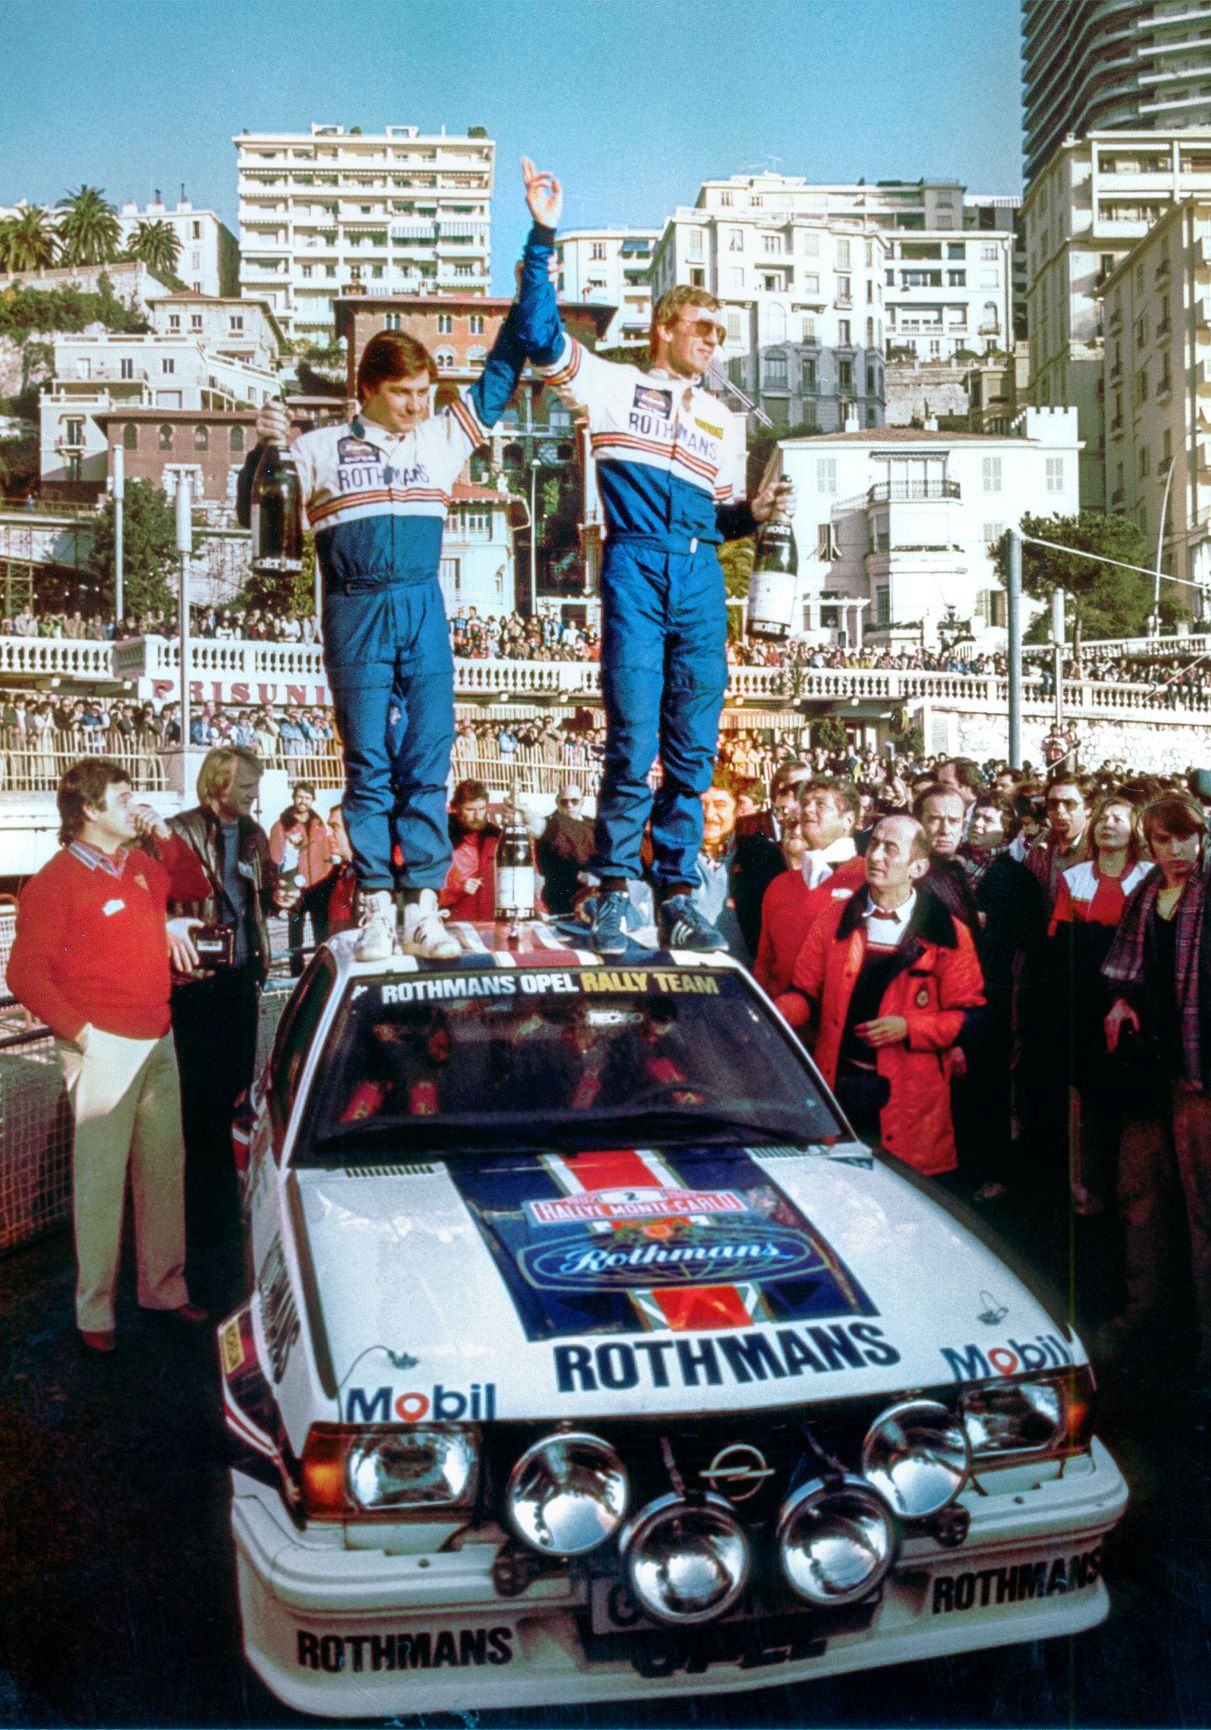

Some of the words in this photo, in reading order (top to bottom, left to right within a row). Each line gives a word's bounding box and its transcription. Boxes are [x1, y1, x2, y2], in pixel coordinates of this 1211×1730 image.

[381, 975, 517, 1004] ROTHMANS
[520, 973, 580, 994] OPEL
[581, 972, 648, 993] RALLY
[653, 973, 720, 995] TEAM
[624, 1191, 636, 1201] 2
[559, 1241, 795, 1276] Rothmans
[553, 1321, 902, 1393] ROTHMANS
[939, 1334, 1072, 1382] Mobil
[346, 1383, 496, 1424] Mobil
[932, 1547, 1103, 1616] ROTHMANS
[296, 1626, 513, 1674] ROTHMANS
